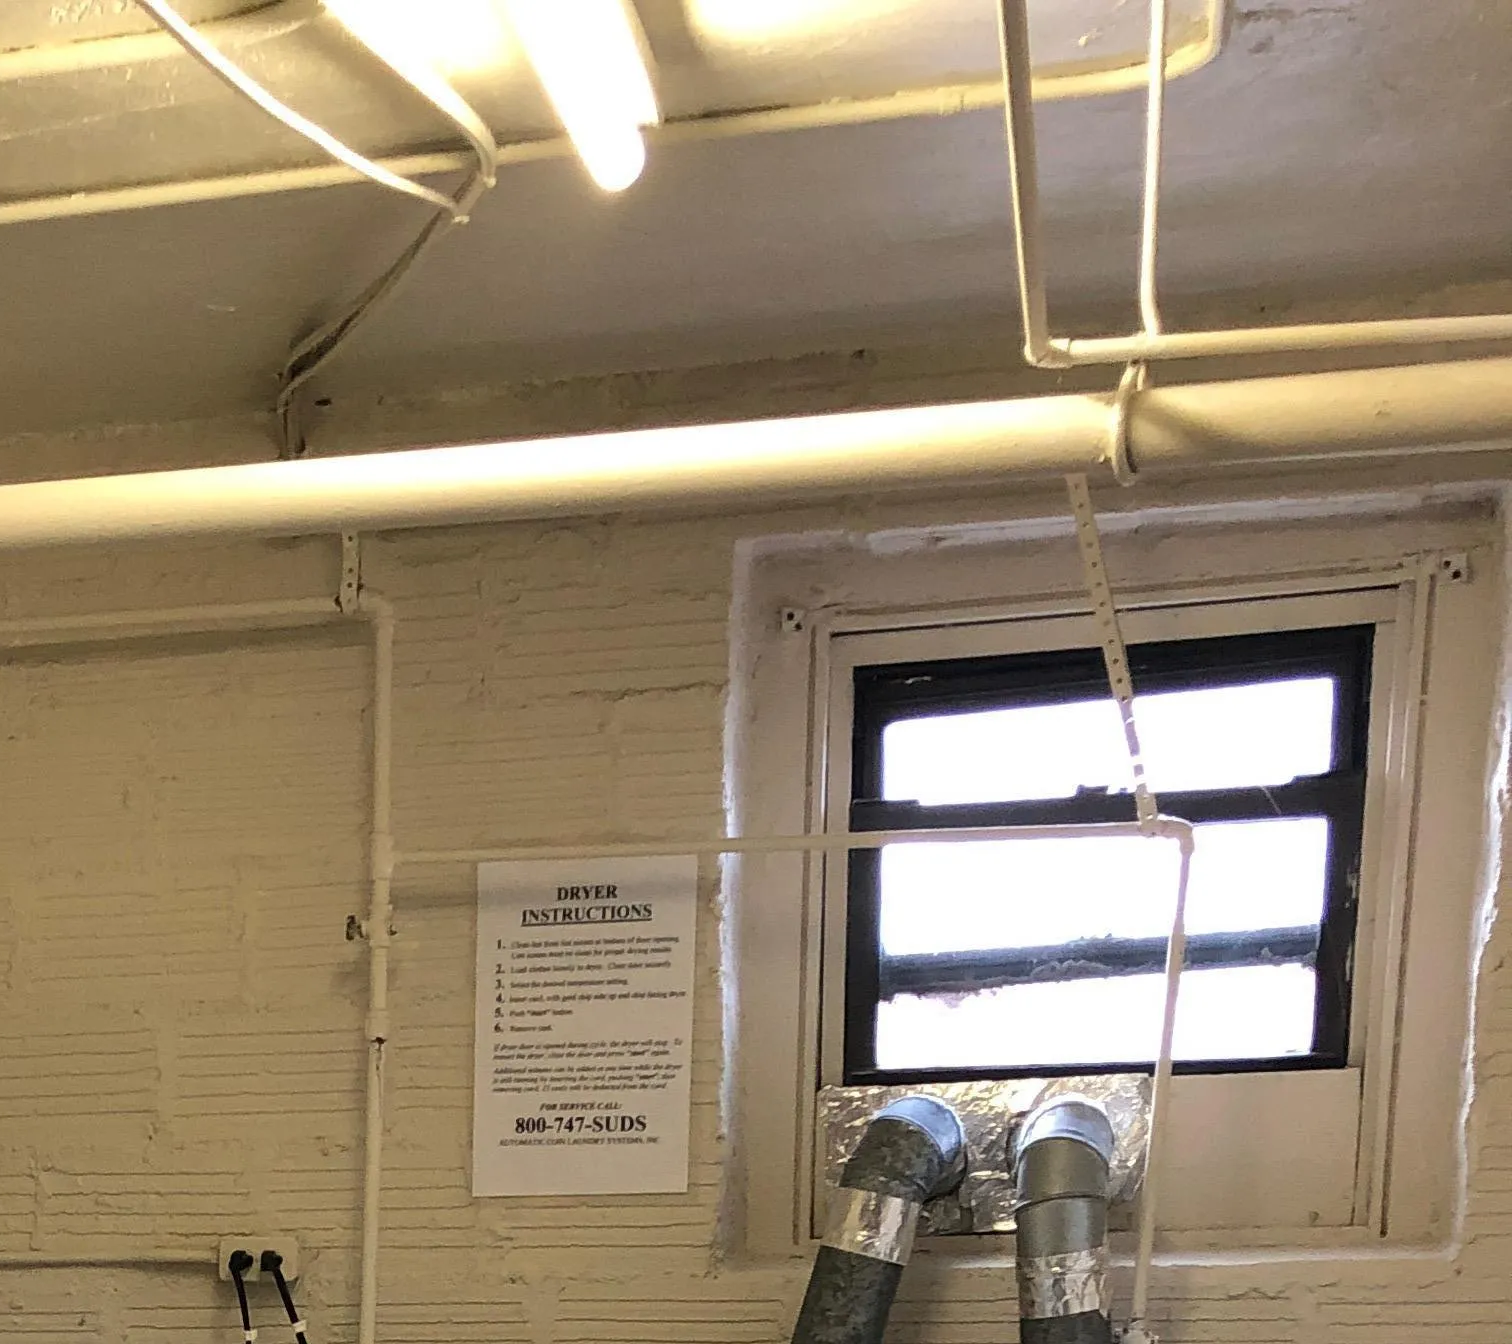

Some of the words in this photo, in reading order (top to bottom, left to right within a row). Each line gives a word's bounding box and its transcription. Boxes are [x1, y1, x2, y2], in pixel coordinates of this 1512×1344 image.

[557, 884, 618, 901] DRYER
[522, 903, 653, 924] INSTRUCTIONS
[515, 1115, 648, 1134] 800-747-SUDS
